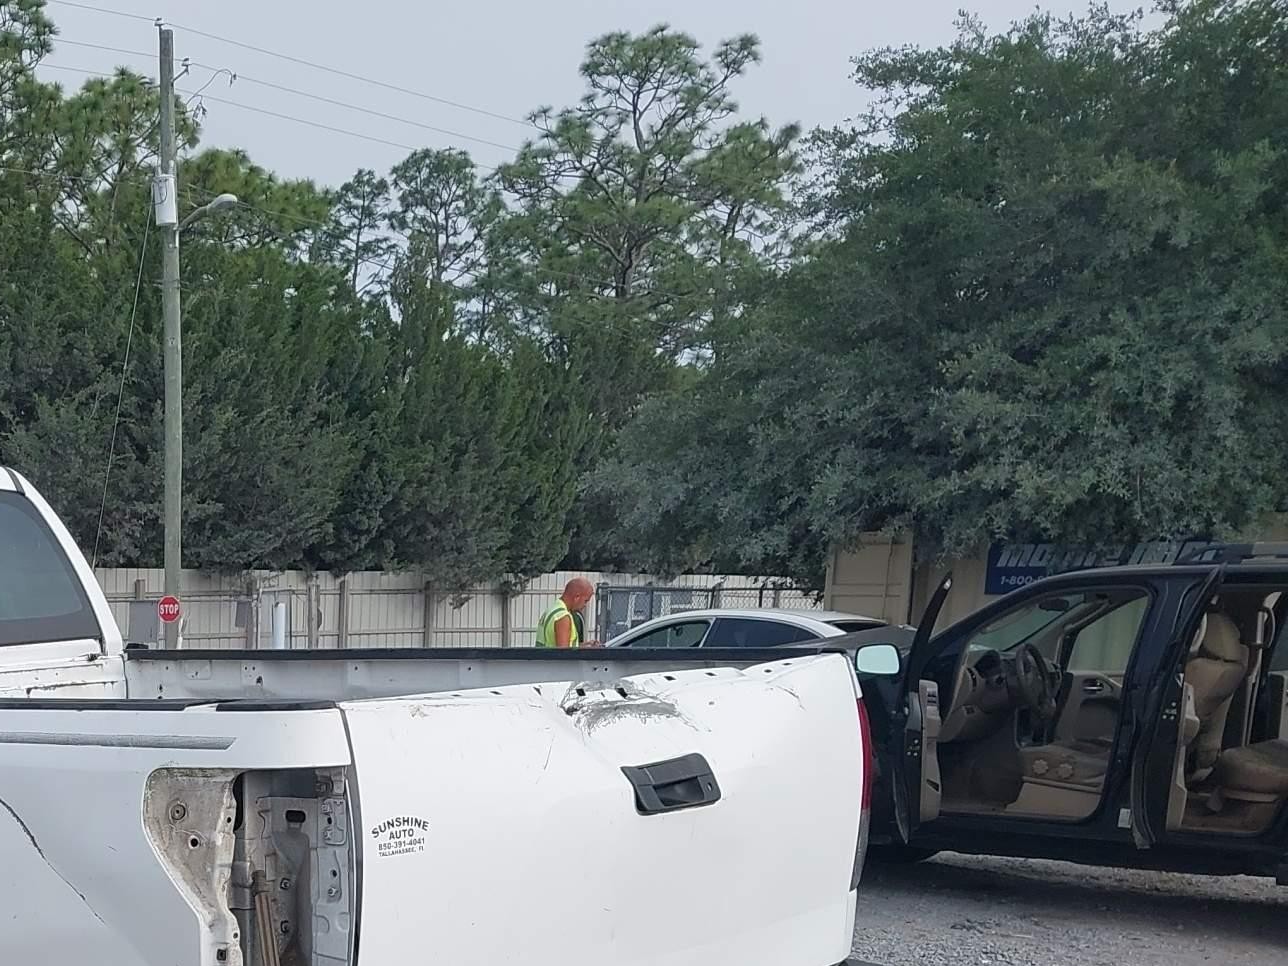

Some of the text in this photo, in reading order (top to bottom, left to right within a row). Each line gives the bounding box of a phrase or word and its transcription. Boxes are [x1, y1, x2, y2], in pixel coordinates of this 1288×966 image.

[159, 604, 179, 615] STOP
[371, 816, 430, 839] SUNSHINE
[389, 828, 415, 841] AUTO
[378, 837, 425, 851] 850-391-4041
